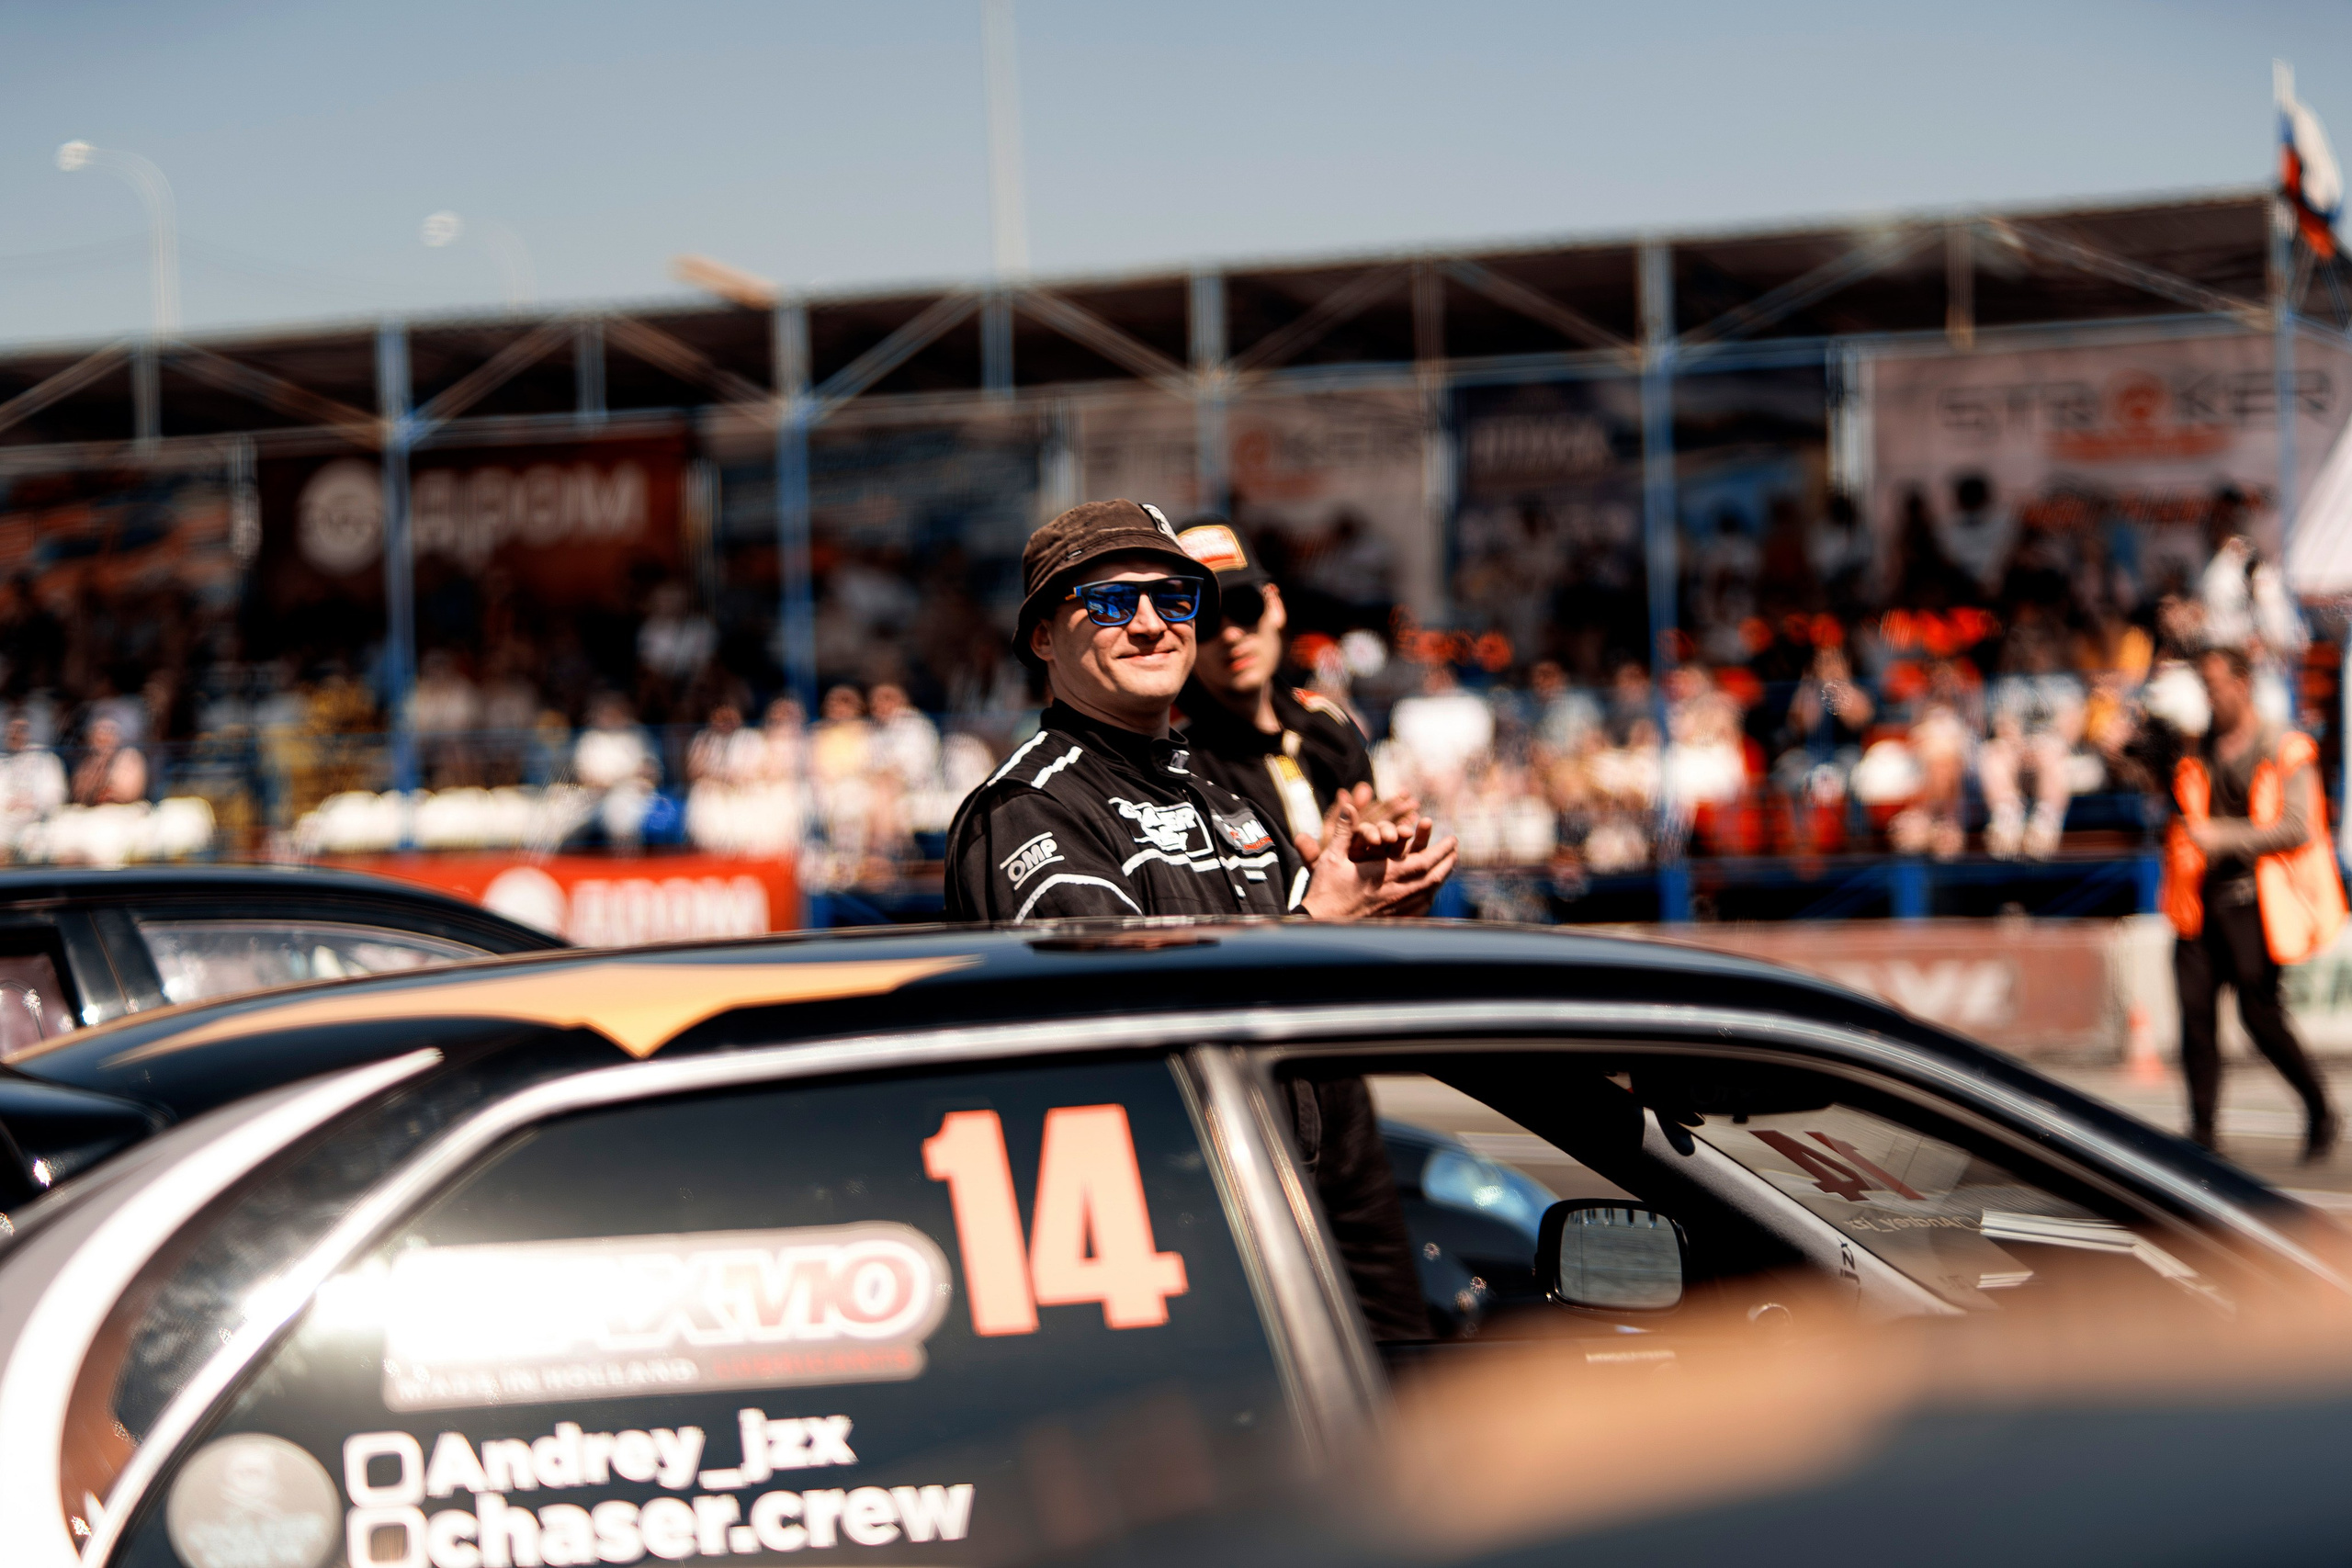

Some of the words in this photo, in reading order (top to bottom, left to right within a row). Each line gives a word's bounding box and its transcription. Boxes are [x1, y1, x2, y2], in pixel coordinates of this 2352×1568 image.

[1007, 838, 1057, 882] OMP
[921, 1103, 1189, 1337] 14
[544, 1357, 700, 1390] HOLLAND
[426, 1407, 858, 1495] Andrey_jzx
[426, 1481, 976, 1568] chaser.crew
